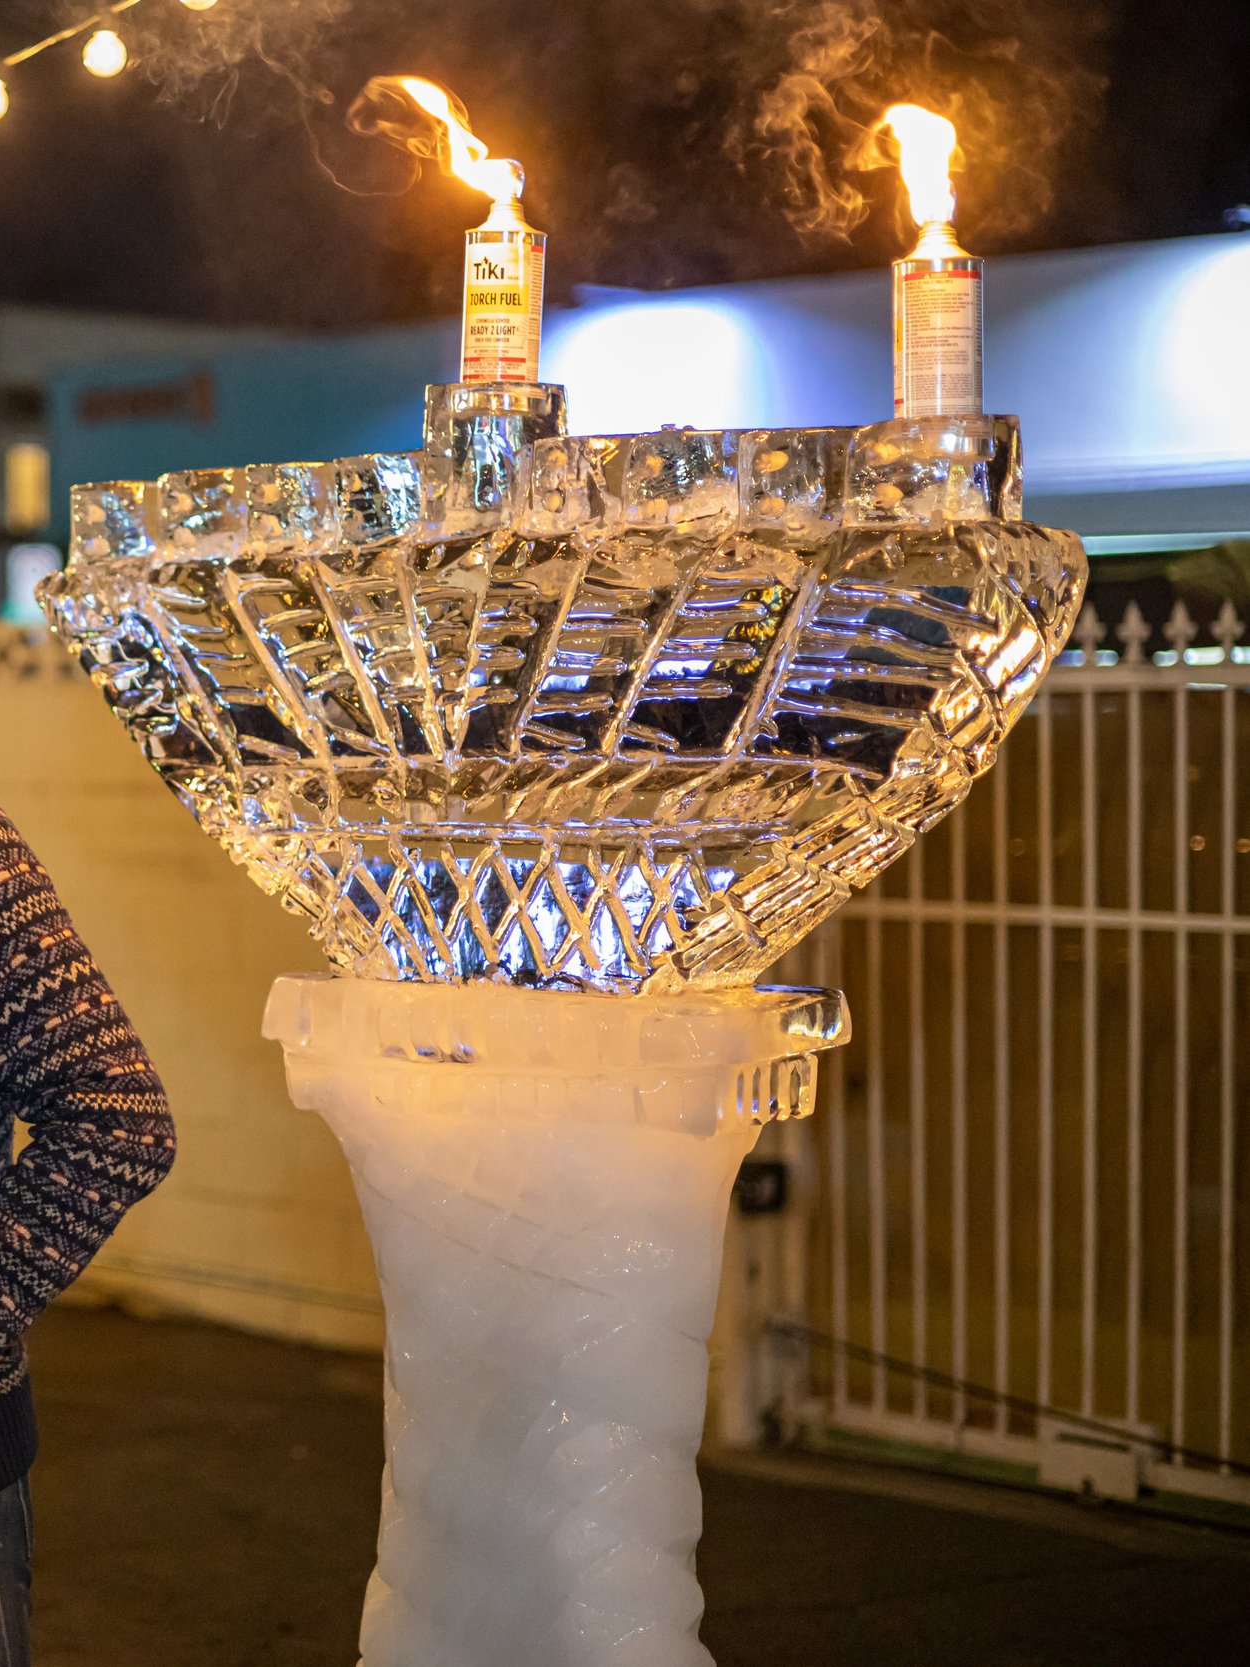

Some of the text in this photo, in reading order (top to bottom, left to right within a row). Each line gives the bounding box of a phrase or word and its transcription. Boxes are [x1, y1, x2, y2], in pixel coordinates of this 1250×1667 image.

[470, 292, 522, 306] TORCH FUEL
[470, 325, 488, 336] READY
